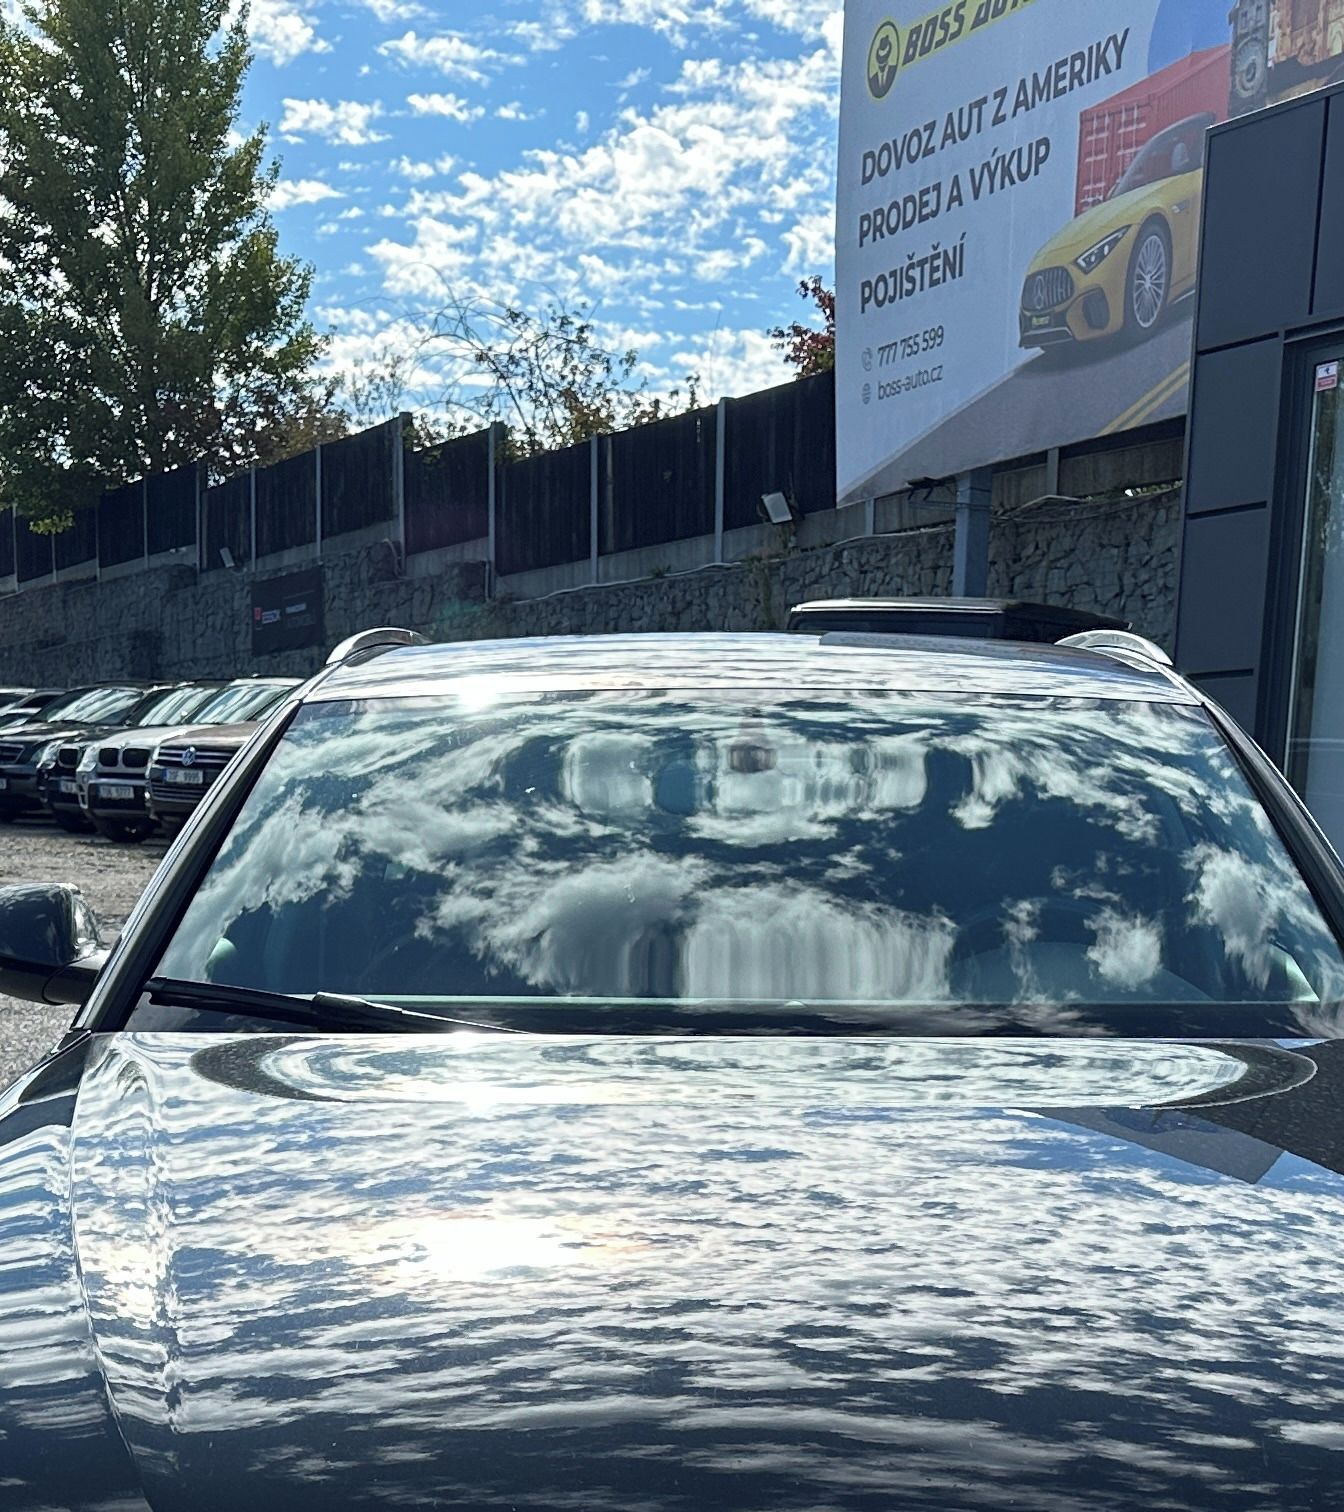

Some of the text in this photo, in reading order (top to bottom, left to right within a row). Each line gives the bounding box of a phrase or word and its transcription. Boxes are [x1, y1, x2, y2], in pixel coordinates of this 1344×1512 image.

[902, 0, 966, 67] BOSS
[861, 27, 1130, 186] DOVOZ AUT Z AMERIKY
[858, 137, 1051, 248] PRODEJ A VÝKUP
[860, 231, 966, 314] POJIŠTĚNÍ
[878, 325, 944, 367] 777 755 599
[878, 364, 943, 400] boss-auto.cz
